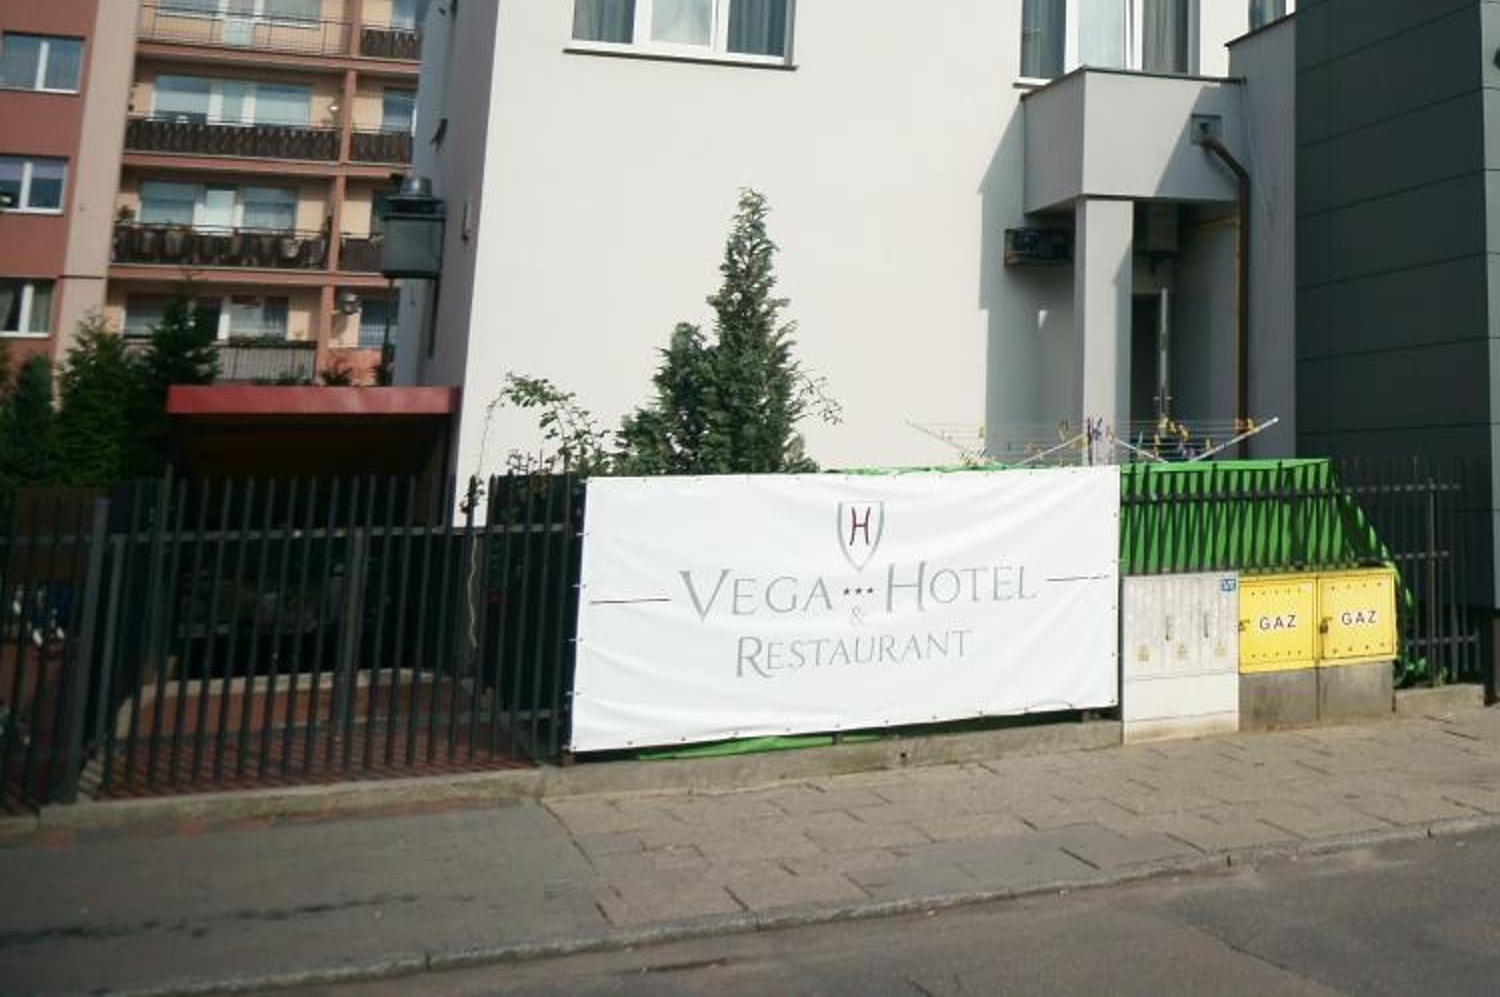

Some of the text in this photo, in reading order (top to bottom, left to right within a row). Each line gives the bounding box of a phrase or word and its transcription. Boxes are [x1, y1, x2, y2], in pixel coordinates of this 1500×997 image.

[850, 507, 871, 545] H
[679, 561, 1039, 622] VEGA HOTEL
[850, 605, 867, 628] &
[1259, 614, 1296, 631] GAZ
[1341, 610, 1377, 626] GAZ
[736, 629, 974, 678] RESTAURANT
